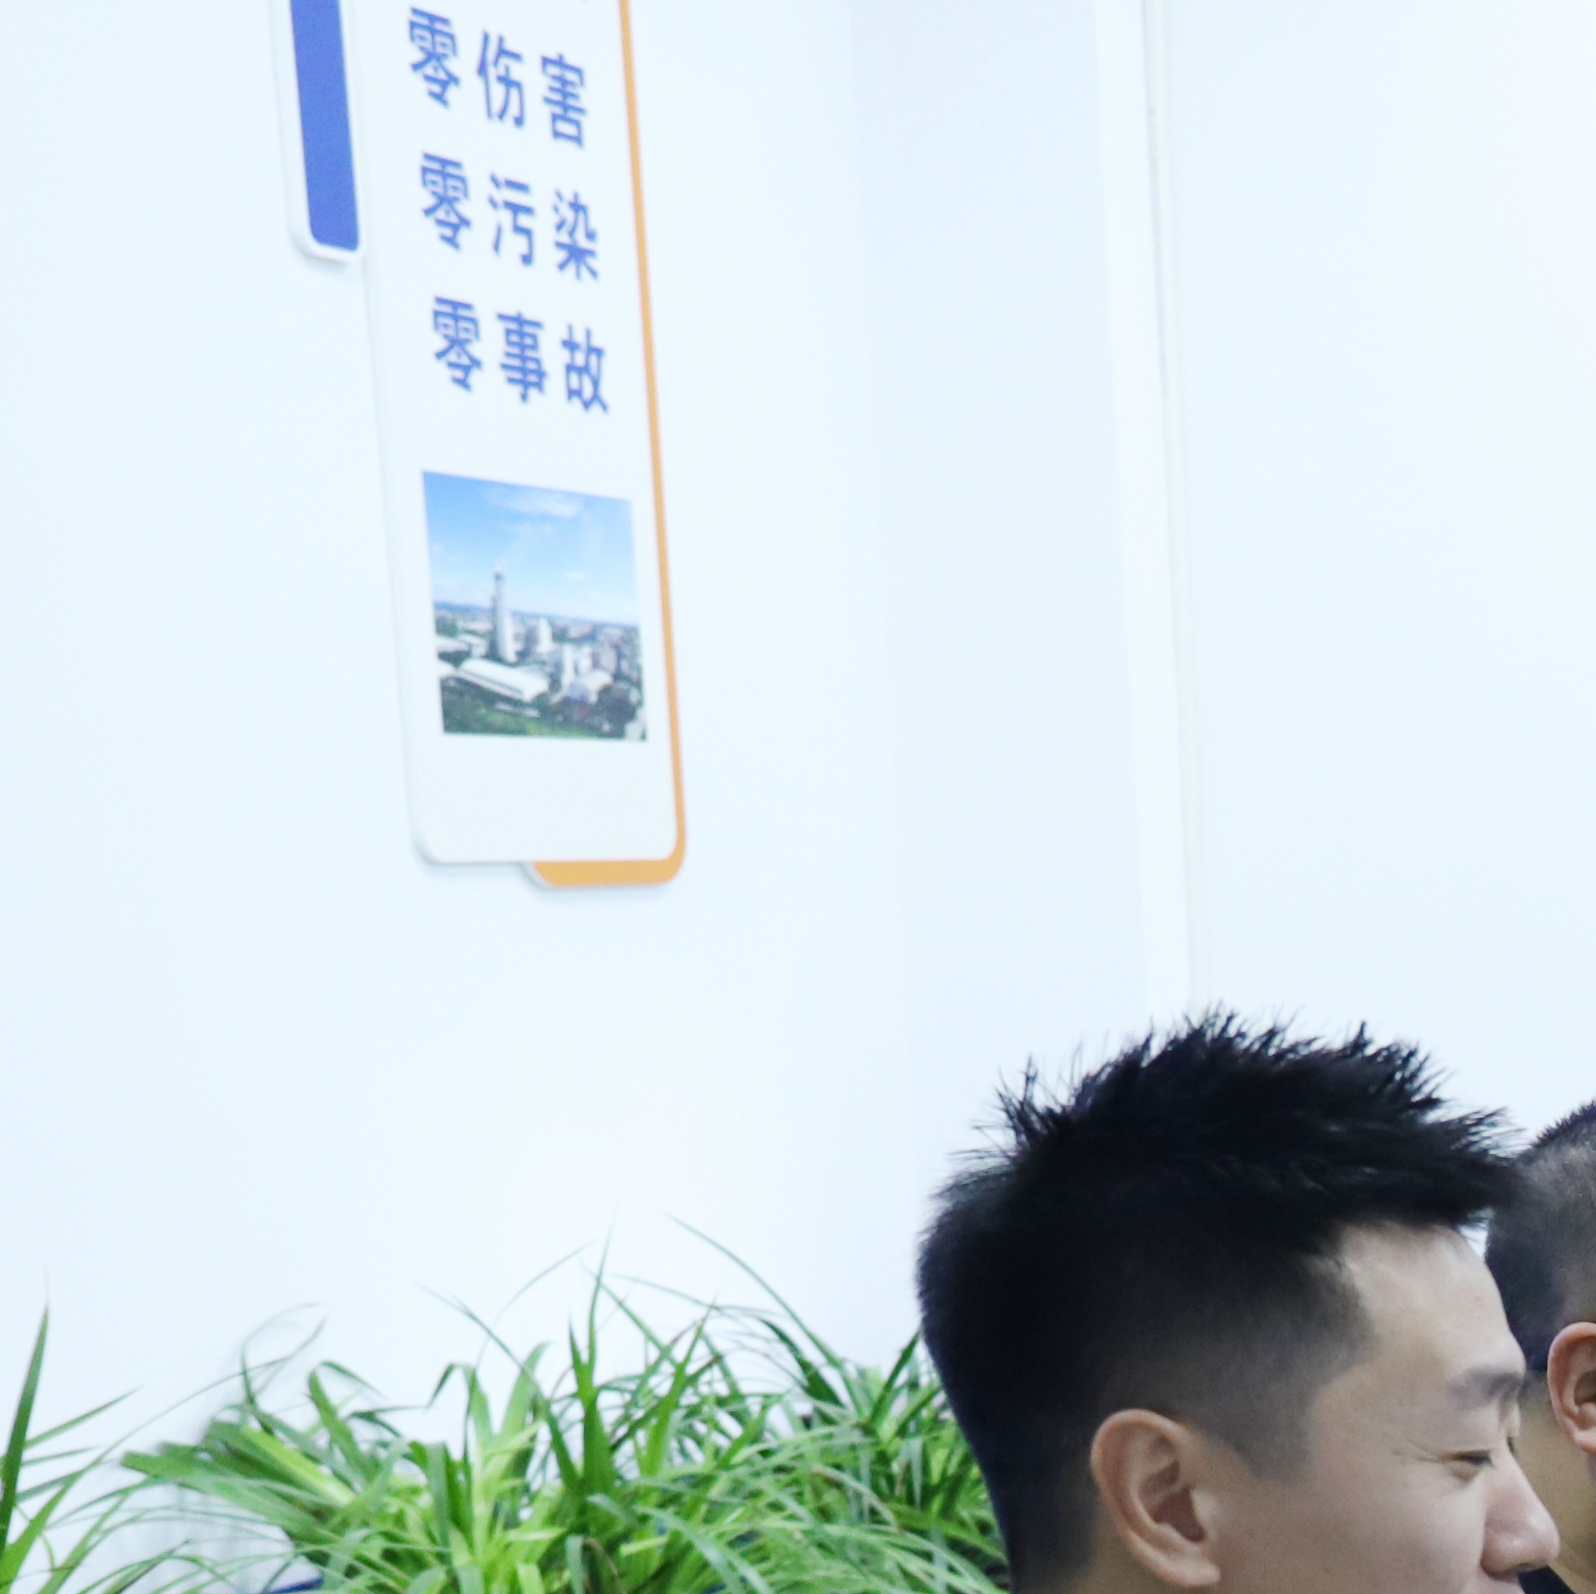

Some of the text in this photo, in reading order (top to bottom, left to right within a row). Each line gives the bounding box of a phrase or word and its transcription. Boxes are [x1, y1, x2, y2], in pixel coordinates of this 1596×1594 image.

[408, 7, 588, 148] 零伤害
[421, 152, 600, 281] 零污染
[433, 296, 609, 414] 零事故
